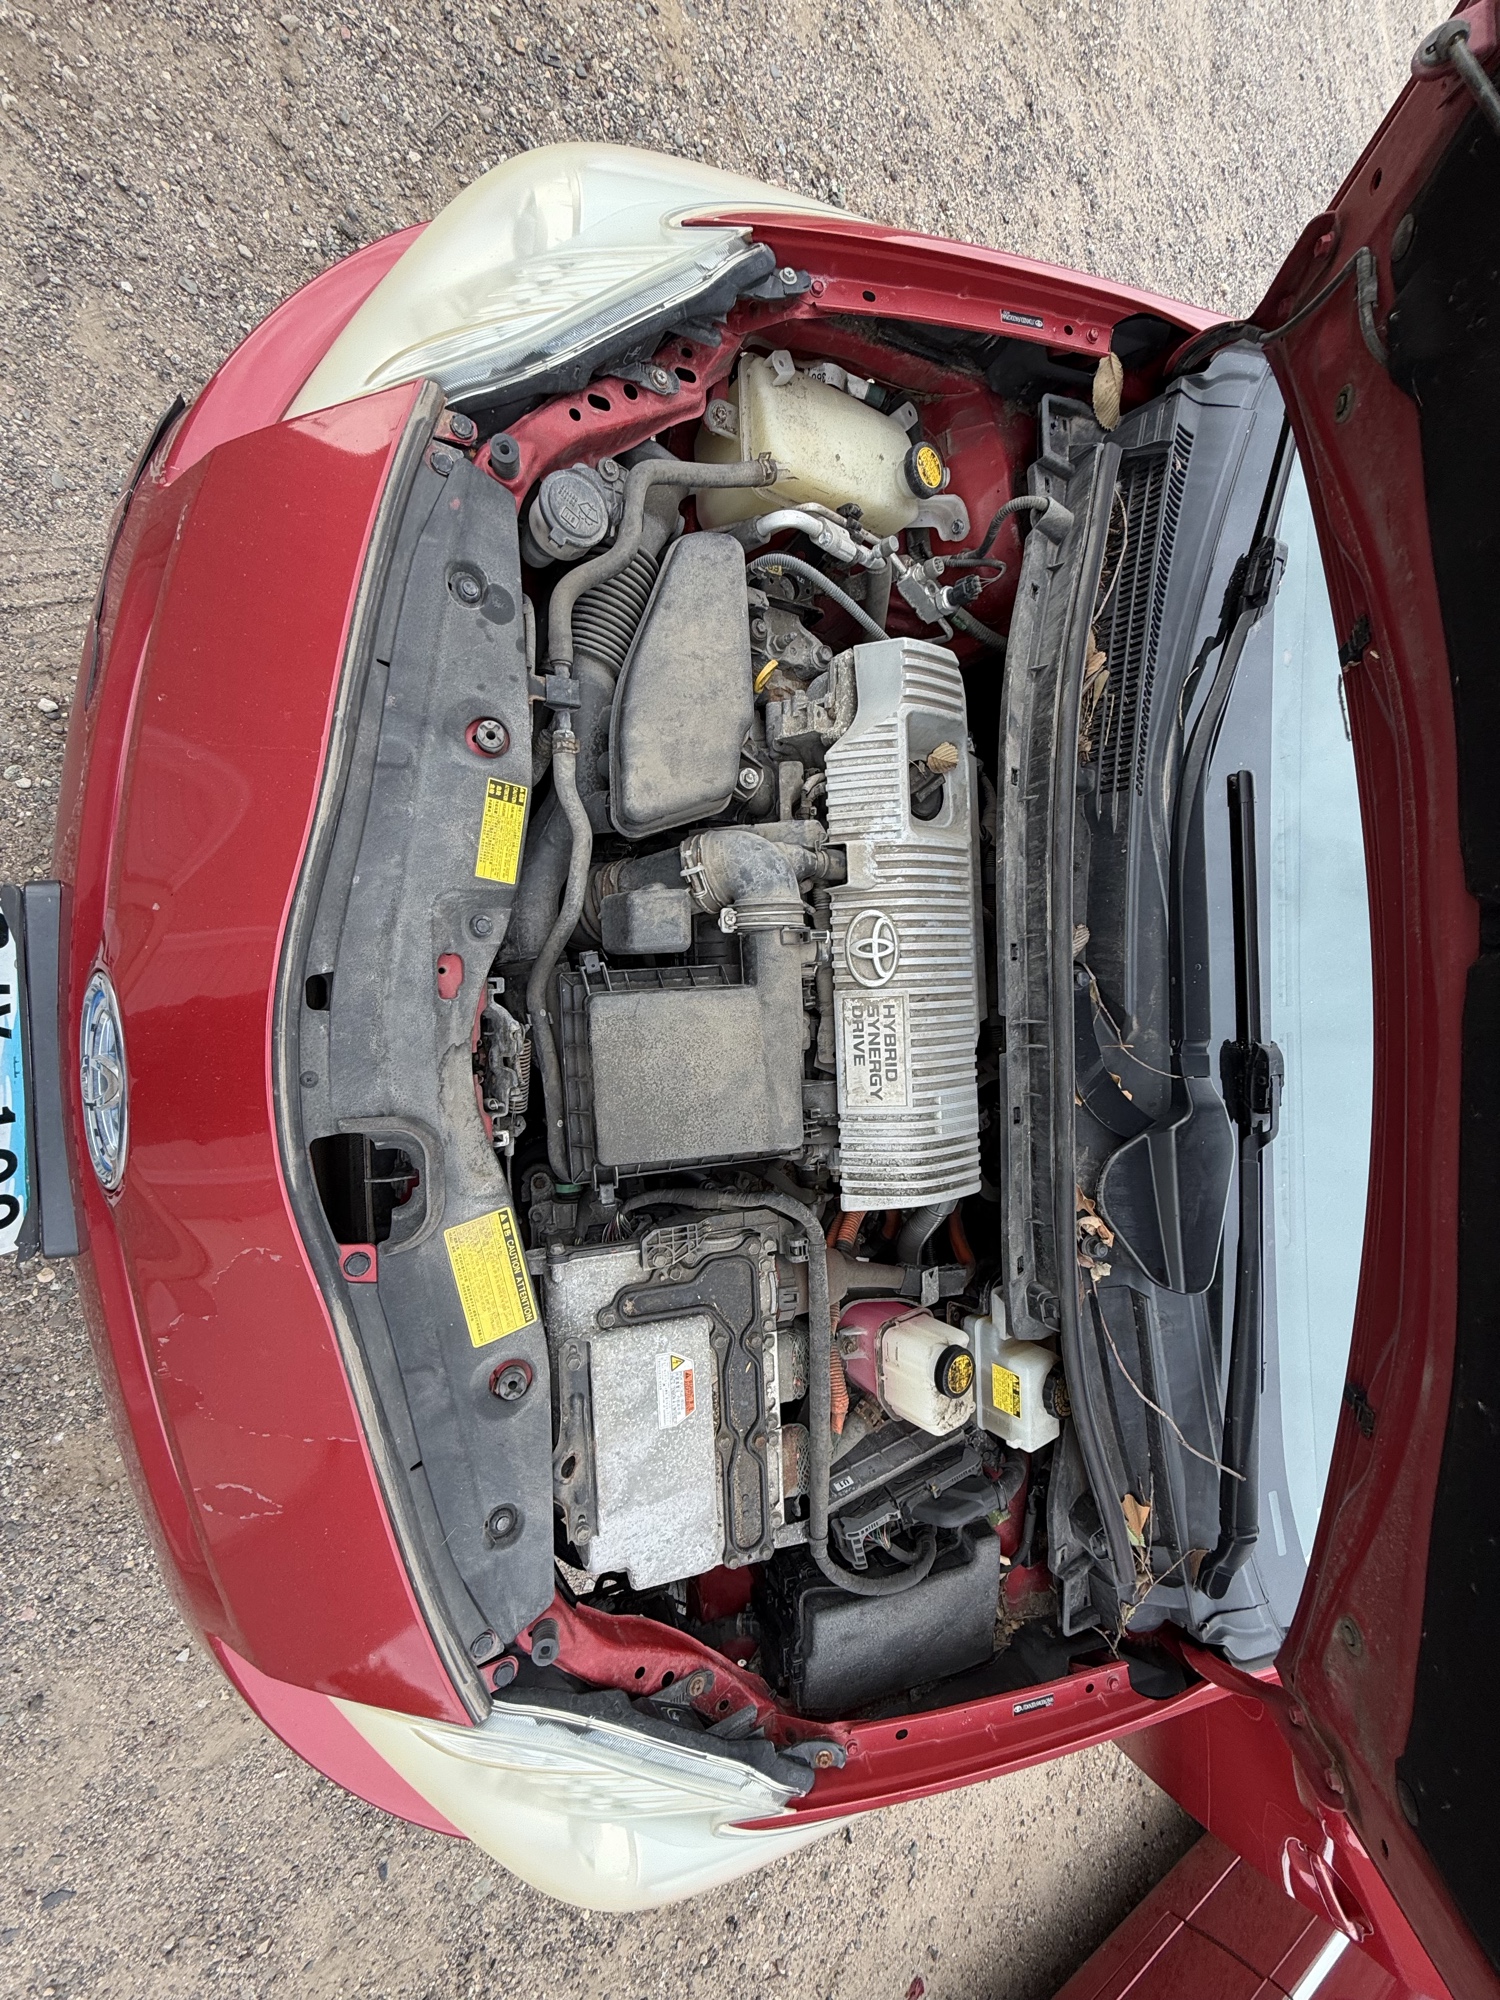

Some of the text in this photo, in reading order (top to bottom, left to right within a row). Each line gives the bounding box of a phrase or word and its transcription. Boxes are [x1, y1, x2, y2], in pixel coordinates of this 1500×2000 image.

[851, 1005, 866, 1067] DRIVE
[866, 1004, 883, 1101] SYNERGY
[882, 1004, 898, 1082] HYBRID
[506, 1239, 521, 1275] CAUTION
[515, 1276, 533, 1321] ATTENTION
